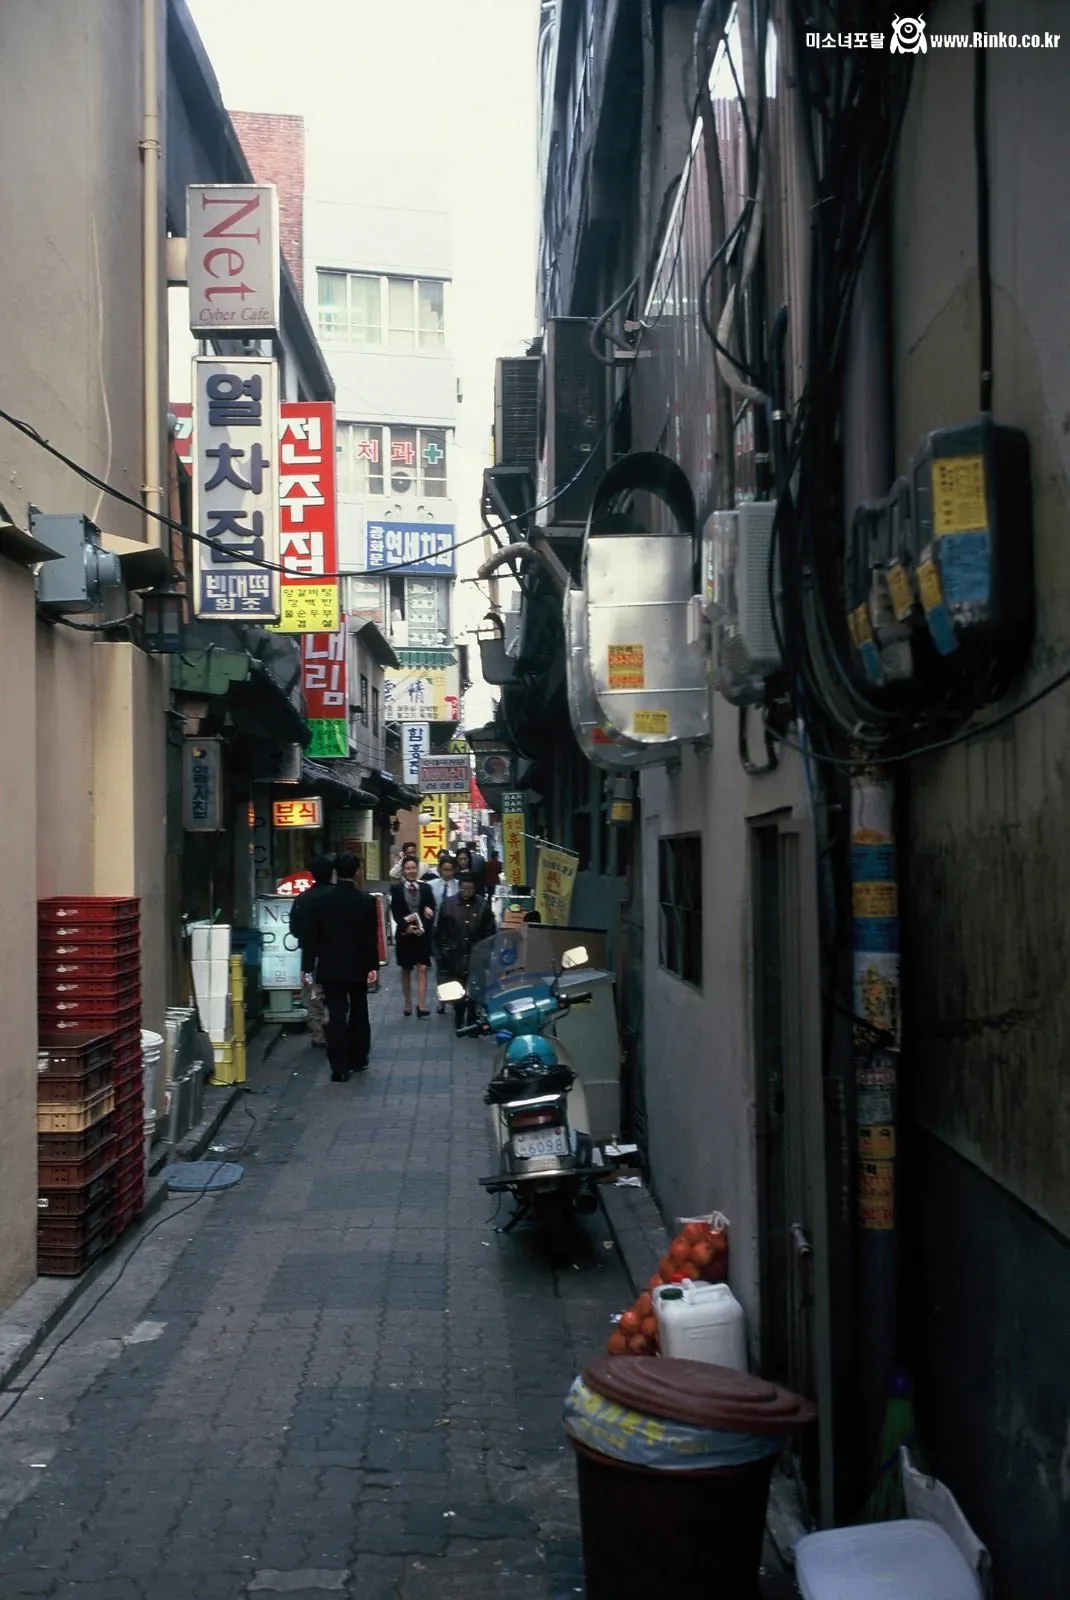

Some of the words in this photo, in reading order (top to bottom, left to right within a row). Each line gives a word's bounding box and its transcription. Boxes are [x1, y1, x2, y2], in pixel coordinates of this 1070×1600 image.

[202, 192, 261, 302] Net
[199, 308, 236, 322] Cyber
[241, 307, 270, 321] Cafe
[357, 439, 415, 465] 치과
[205, 374, 270, 563] 열차집
[369, 526, 383, 566] 광화문
[385, 530, 451, 567] 연세치과
[206, 575, 269, 598] 빈대떡
[216, 598, 261, 611] 원조
[276, 802, 316, 824] 분식
[264, 905, 291, 925] Ne
[529, 1138, 563, 1154] 6098
